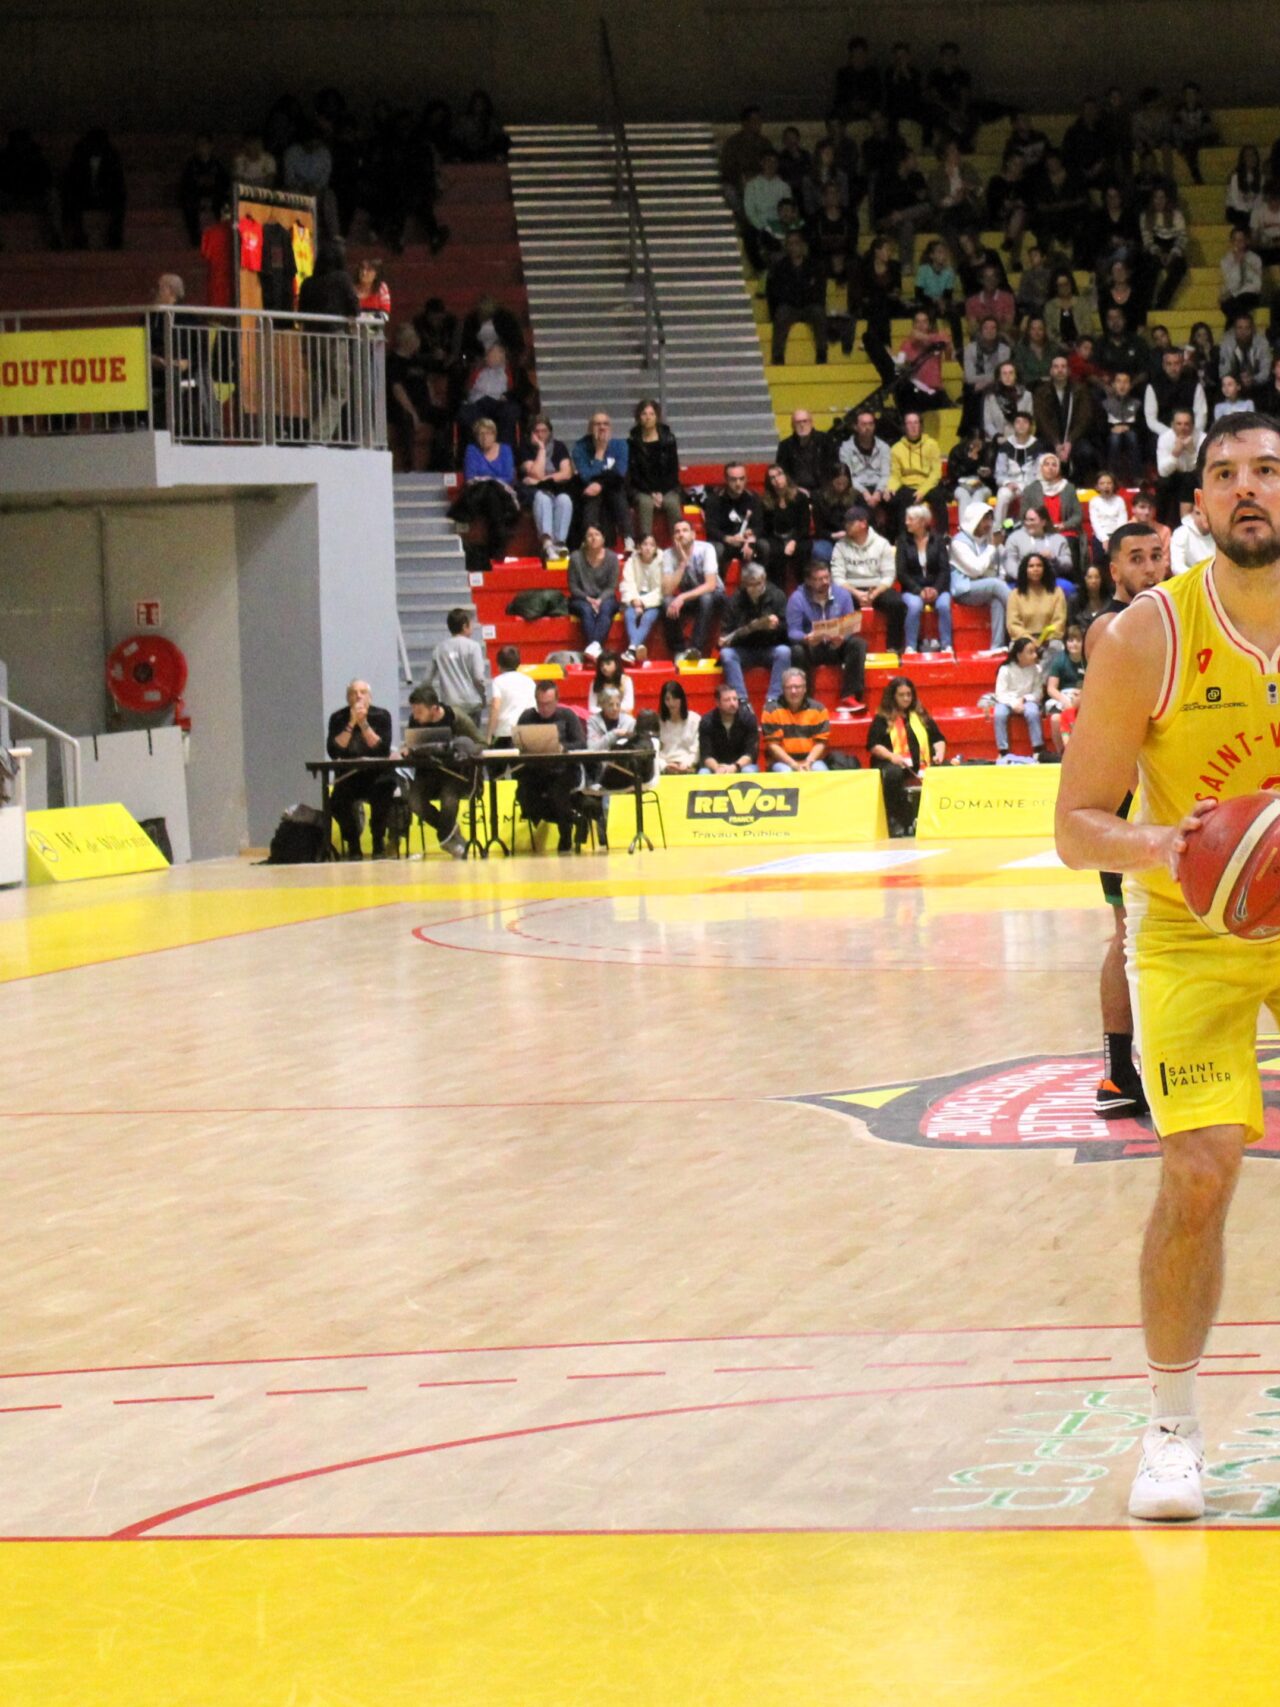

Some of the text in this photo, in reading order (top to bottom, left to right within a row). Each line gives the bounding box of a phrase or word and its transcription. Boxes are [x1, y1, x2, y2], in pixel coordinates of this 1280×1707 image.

[0, 356, 127, 387] OUTIQUE
[1168, 1062, 1215, 1076] SAINT
[1170, 1073, 1232, 1087] VALLIER
